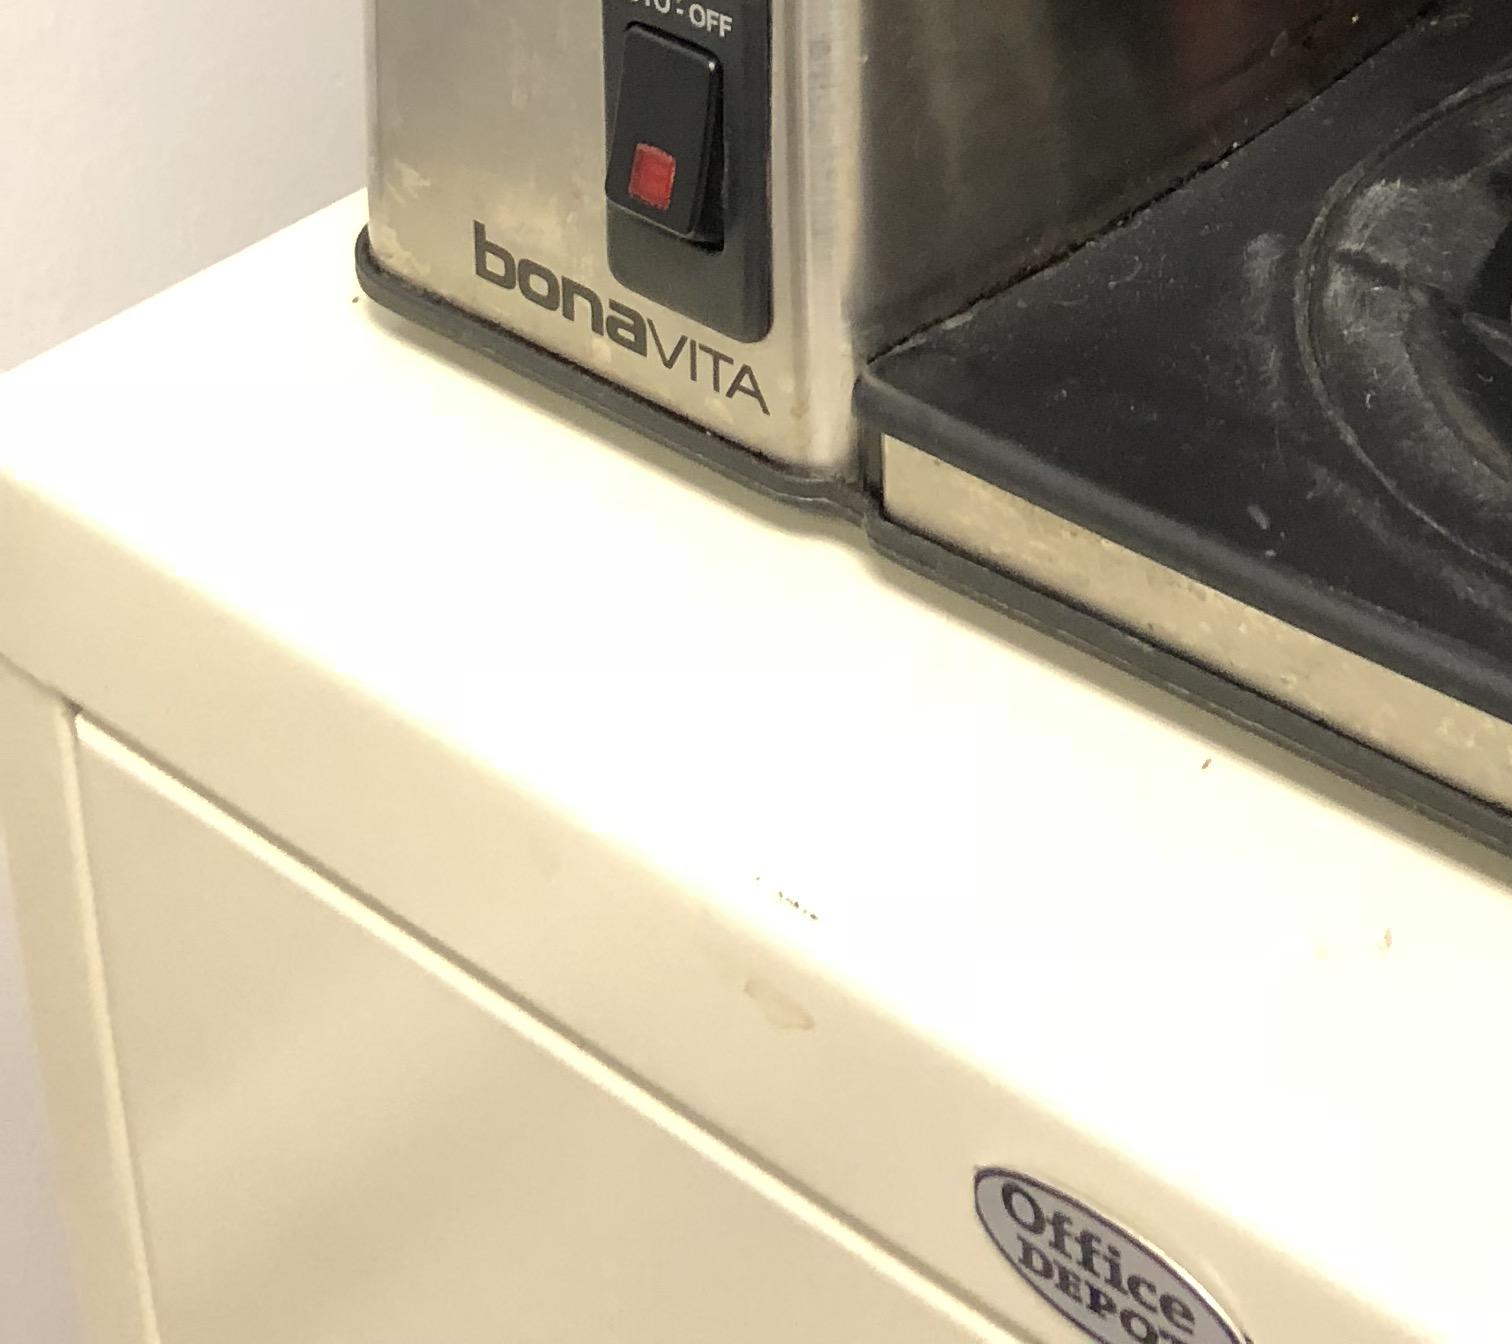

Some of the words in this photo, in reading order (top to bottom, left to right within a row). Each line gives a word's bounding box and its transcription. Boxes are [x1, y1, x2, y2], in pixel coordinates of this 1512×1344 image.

[688, 2, 734, 38] OFF
[472, 218, 771, 417] bonaVITA
[1000, 1180, 1196, 1336] Office
